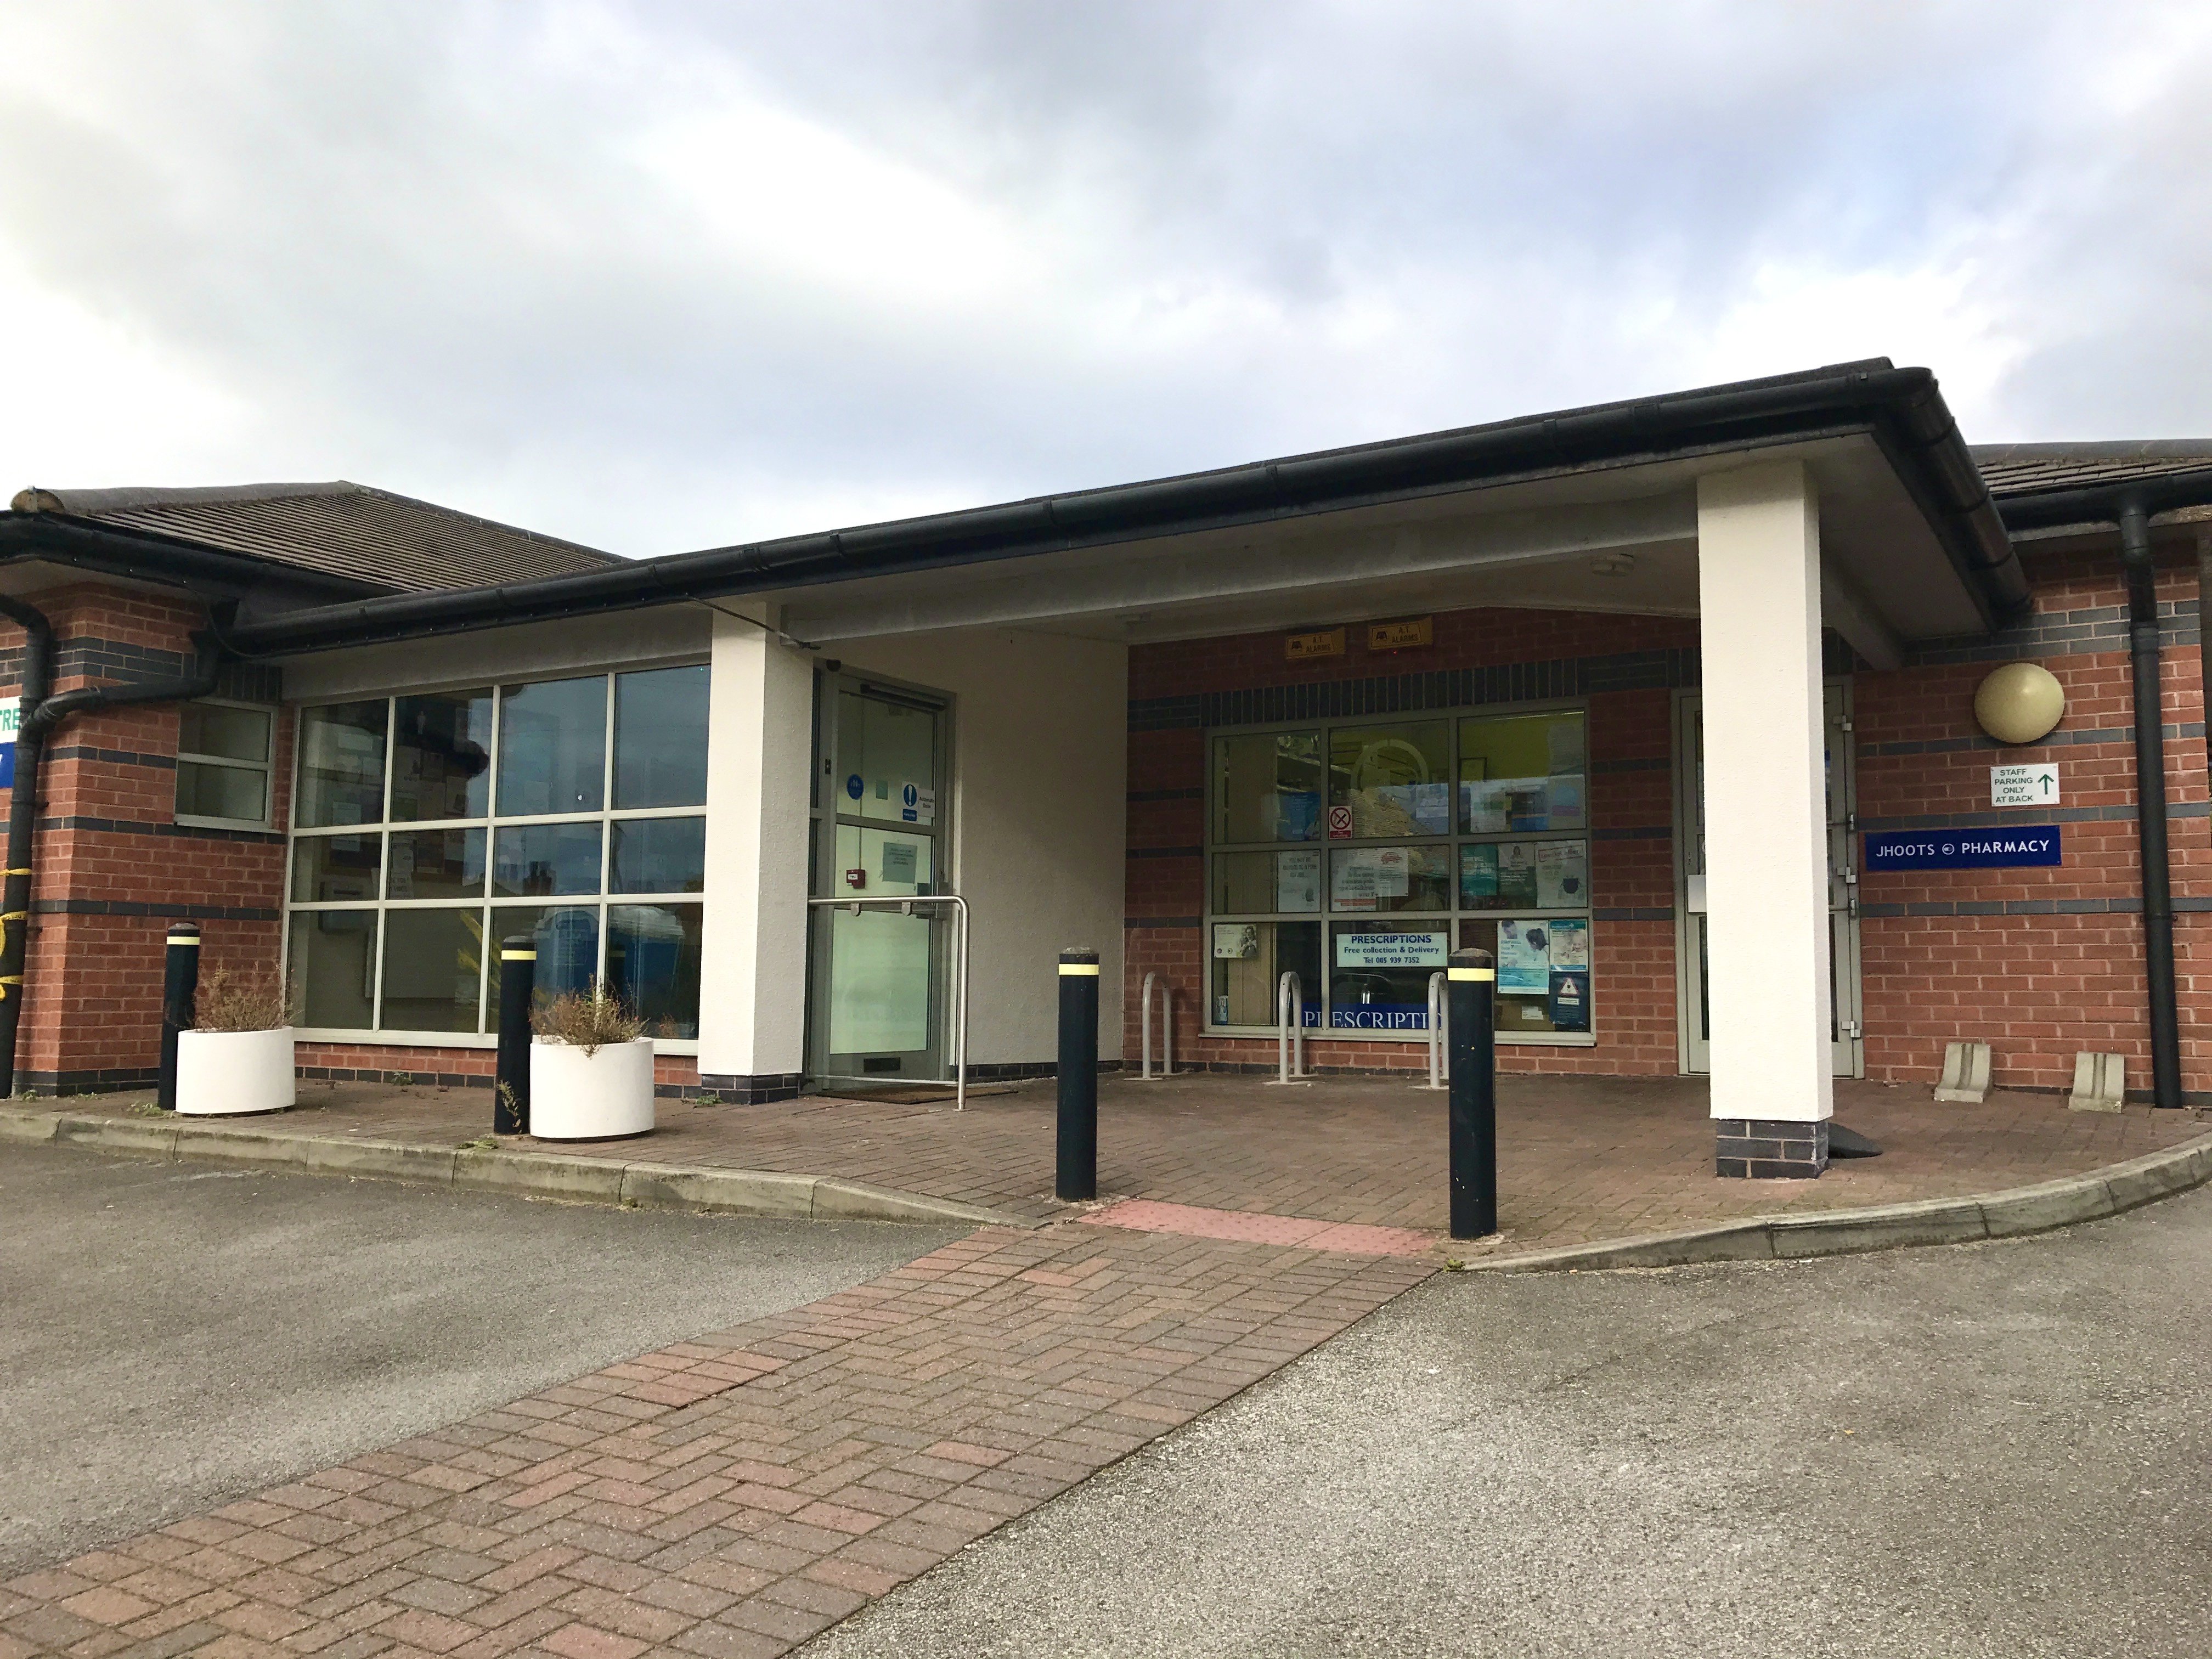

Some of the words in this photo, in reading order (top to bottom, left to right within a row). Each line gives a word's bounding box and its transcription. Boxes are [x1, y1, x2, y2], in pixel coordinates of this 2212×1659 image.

[2000, 768, 2027, 776] STAFF
[1994, 777, 2033, 786] PARKING
[1876, 844, 1935, 857] JHOOTS
[1962, 839, 2050, 854] PHARMACY
[1351, 934, 1432, 944] PRESCRIPTIONS
[1408, 946, 1440, 955] Delivery
